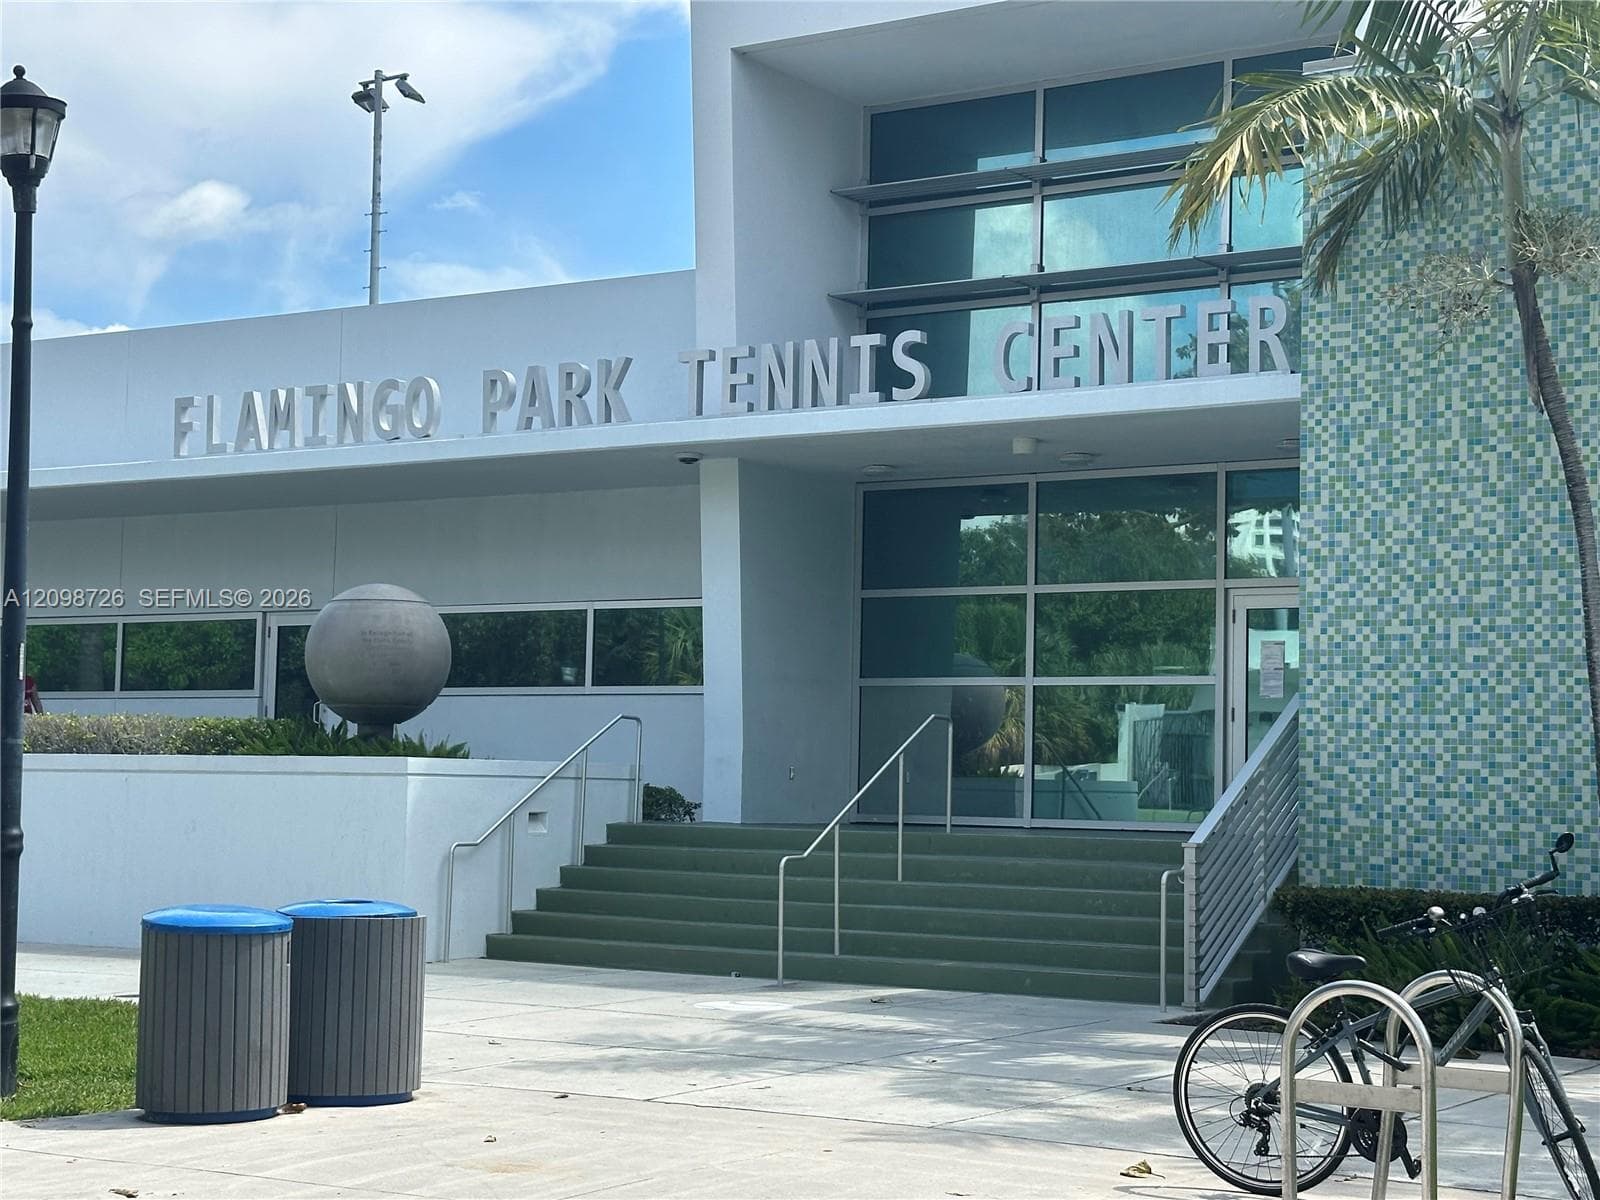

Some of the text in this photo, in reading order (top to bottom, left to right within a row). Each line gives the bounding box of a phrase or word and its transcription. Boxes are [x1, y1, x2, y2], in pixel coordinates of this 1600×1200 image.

[173, 295, 1290, 458] FLAMINGO PARK TENNIS CENTER
